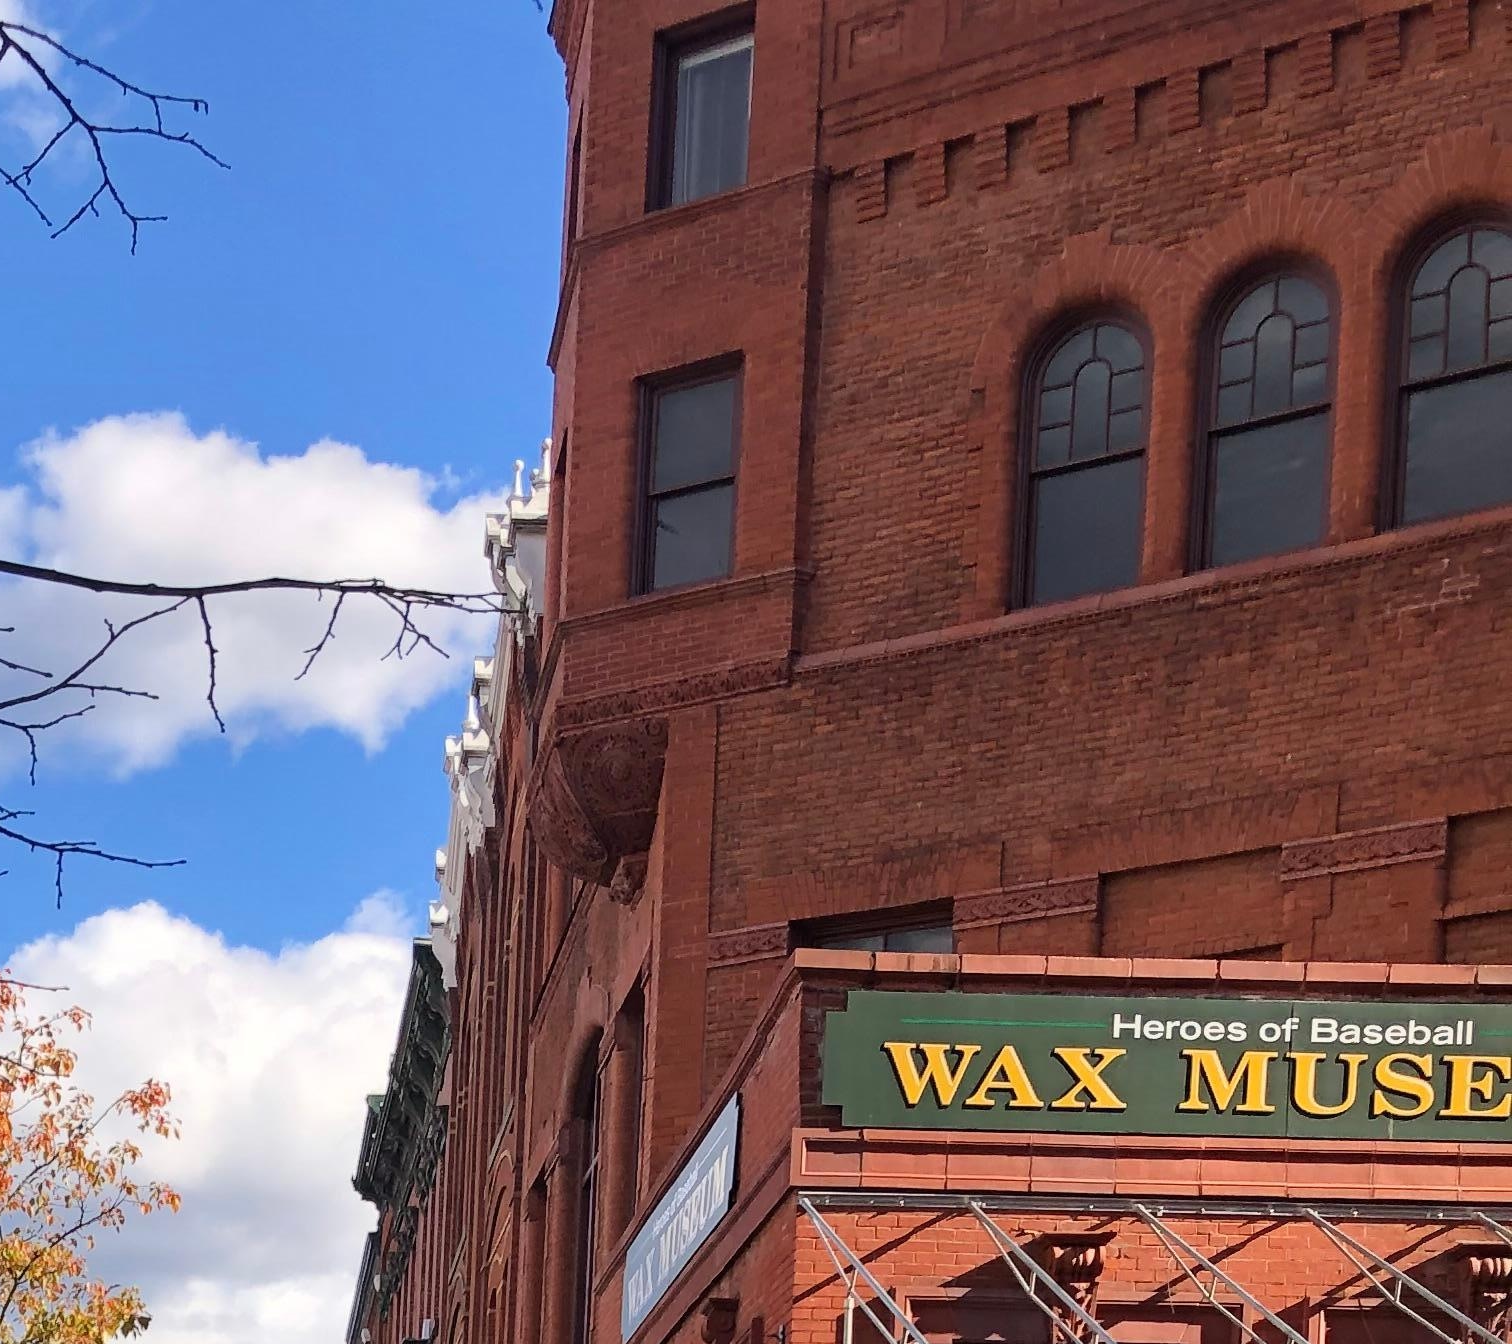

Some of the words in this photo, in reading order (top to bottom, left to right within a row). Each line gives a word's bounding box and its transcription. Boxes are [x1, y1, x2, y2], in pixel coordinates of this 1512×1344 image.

[1112, 1013, 1247, 1043] Heroes
[1259, 1017, 1300, 1044] of
[1310, 1018, 1474, 1047] Baseball
[882, 1040, 1129, 1114] WAX
[1177, 1047, 1512, 1121] MUSE
[657, 1143, 729, 1286] MUSEUM
